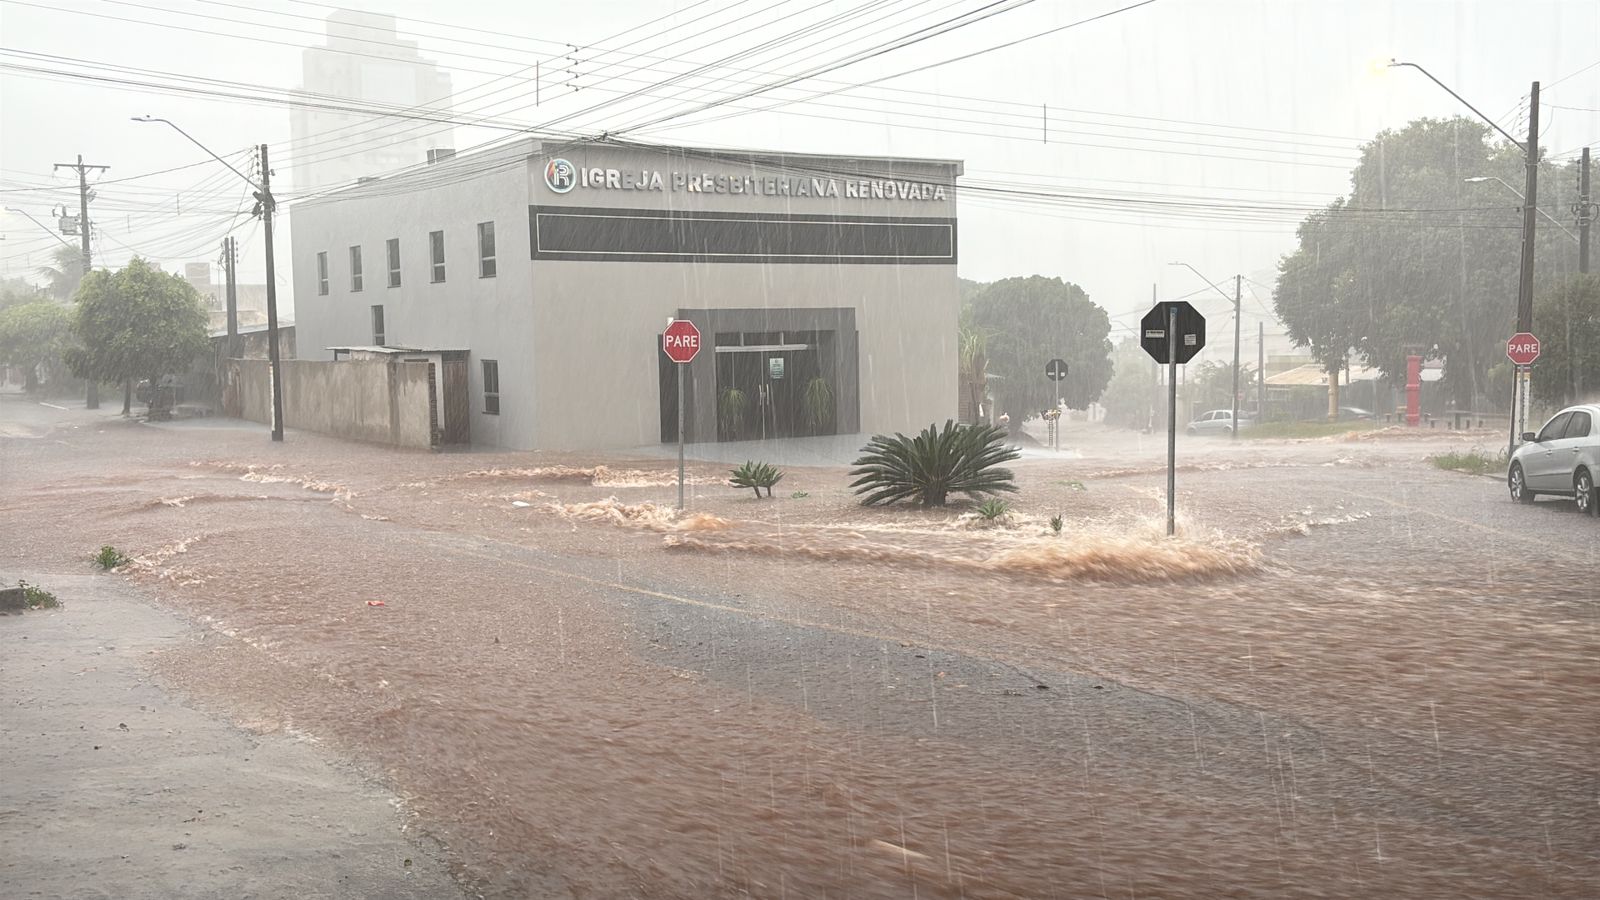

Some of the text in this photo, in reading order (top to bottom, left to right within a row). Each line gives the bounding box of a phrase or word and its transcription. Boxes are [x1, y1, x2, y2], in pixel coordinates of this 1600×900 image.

[581, 167, 947, 201] IGREJA PRESBITERIANA RENOVADA
[666, 335, 697, 347] PARE
[1509, 343, 1537, 353] PARE
